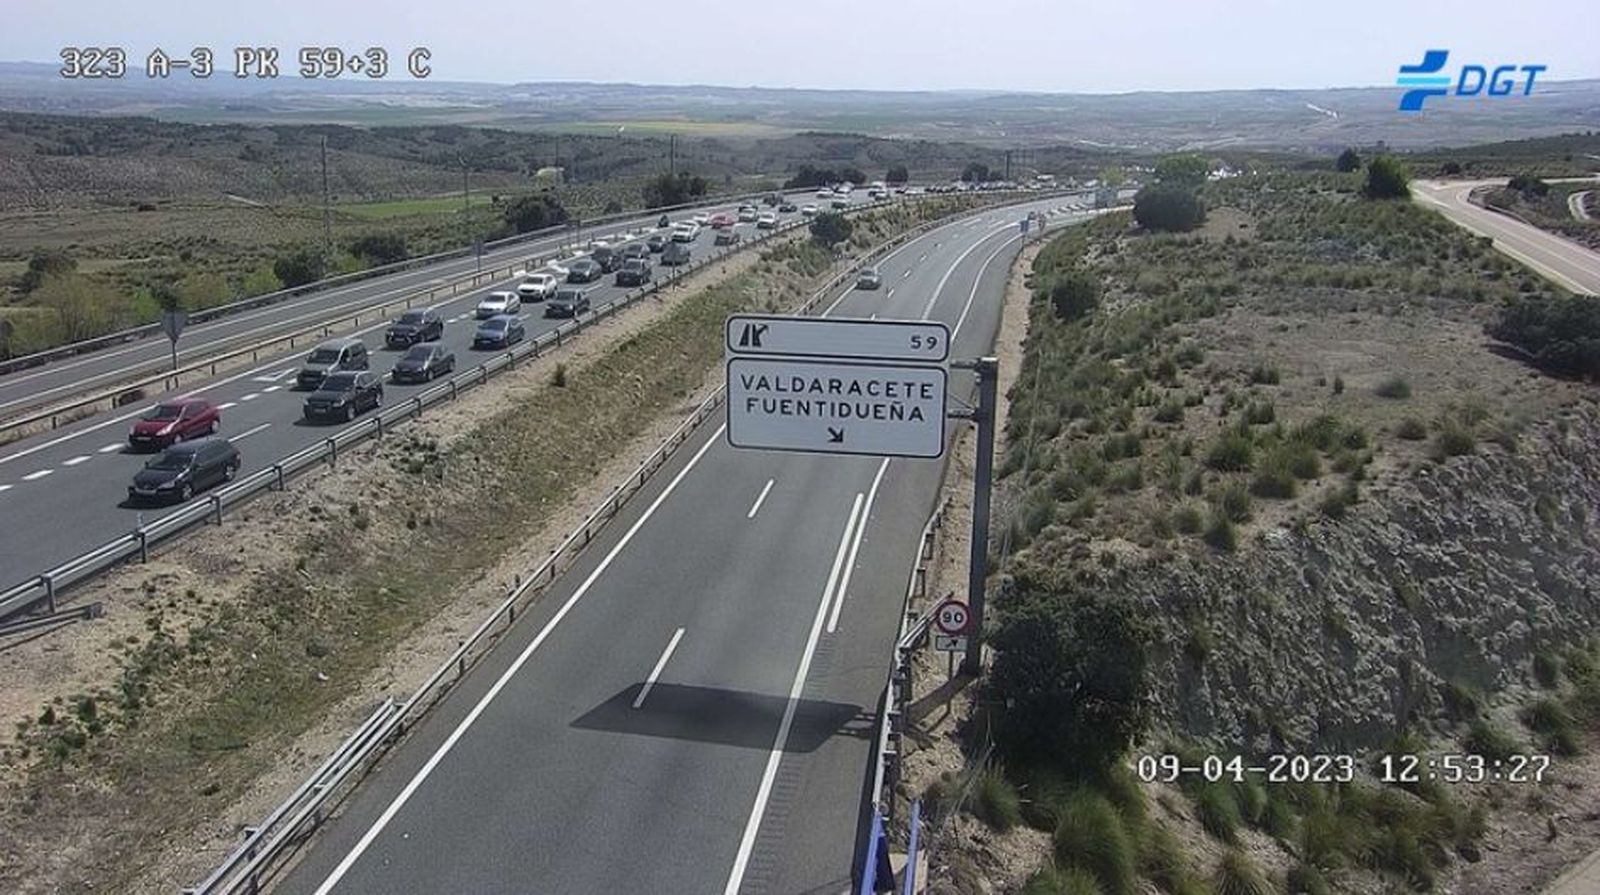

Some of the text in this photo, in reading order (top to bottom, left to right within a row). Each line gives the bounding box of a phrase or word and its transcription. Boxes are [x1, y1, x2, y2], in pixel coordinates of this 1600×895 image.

[910, 336, 938, 350] 59
[740, 374, 934, 399] VALDARACETE
[746, 397, 924, 422] FUENTIDUEÑA
[942, 611, 964, 623] 90
